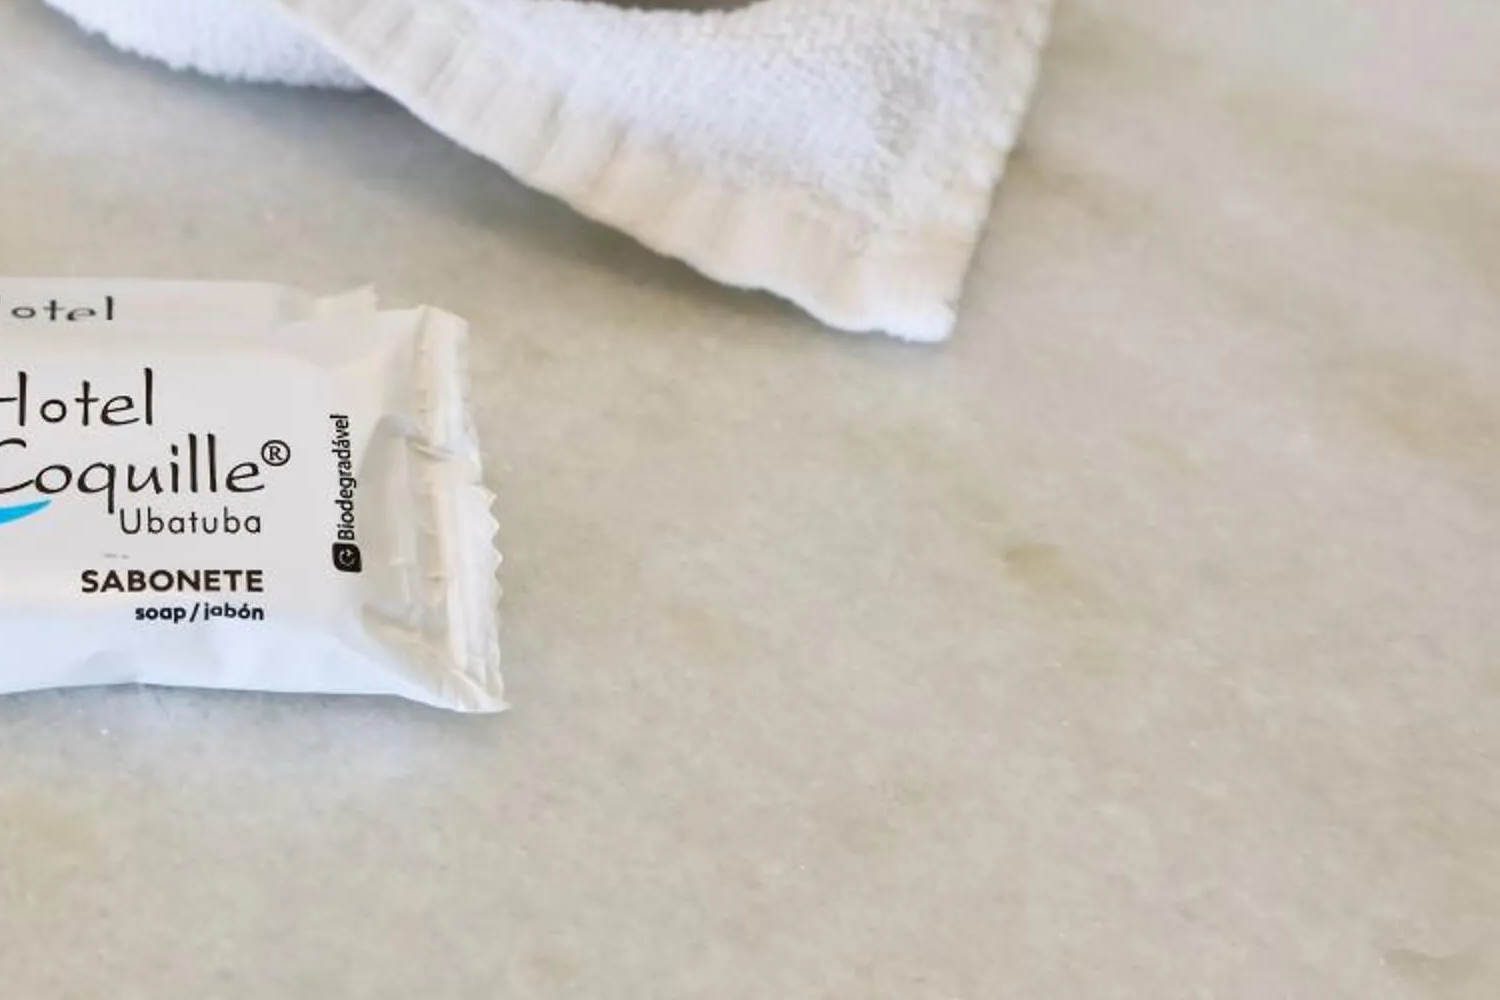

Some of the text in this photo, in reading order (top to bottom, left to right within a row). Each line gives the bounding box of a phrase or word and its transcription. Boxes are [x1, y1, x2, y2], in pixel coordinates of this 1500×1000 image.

[329, 413, 358, 541] Biodegradável
[119, 506, 262, 536] Ubatuba
[81, 569, 265, 593] SABONETE
